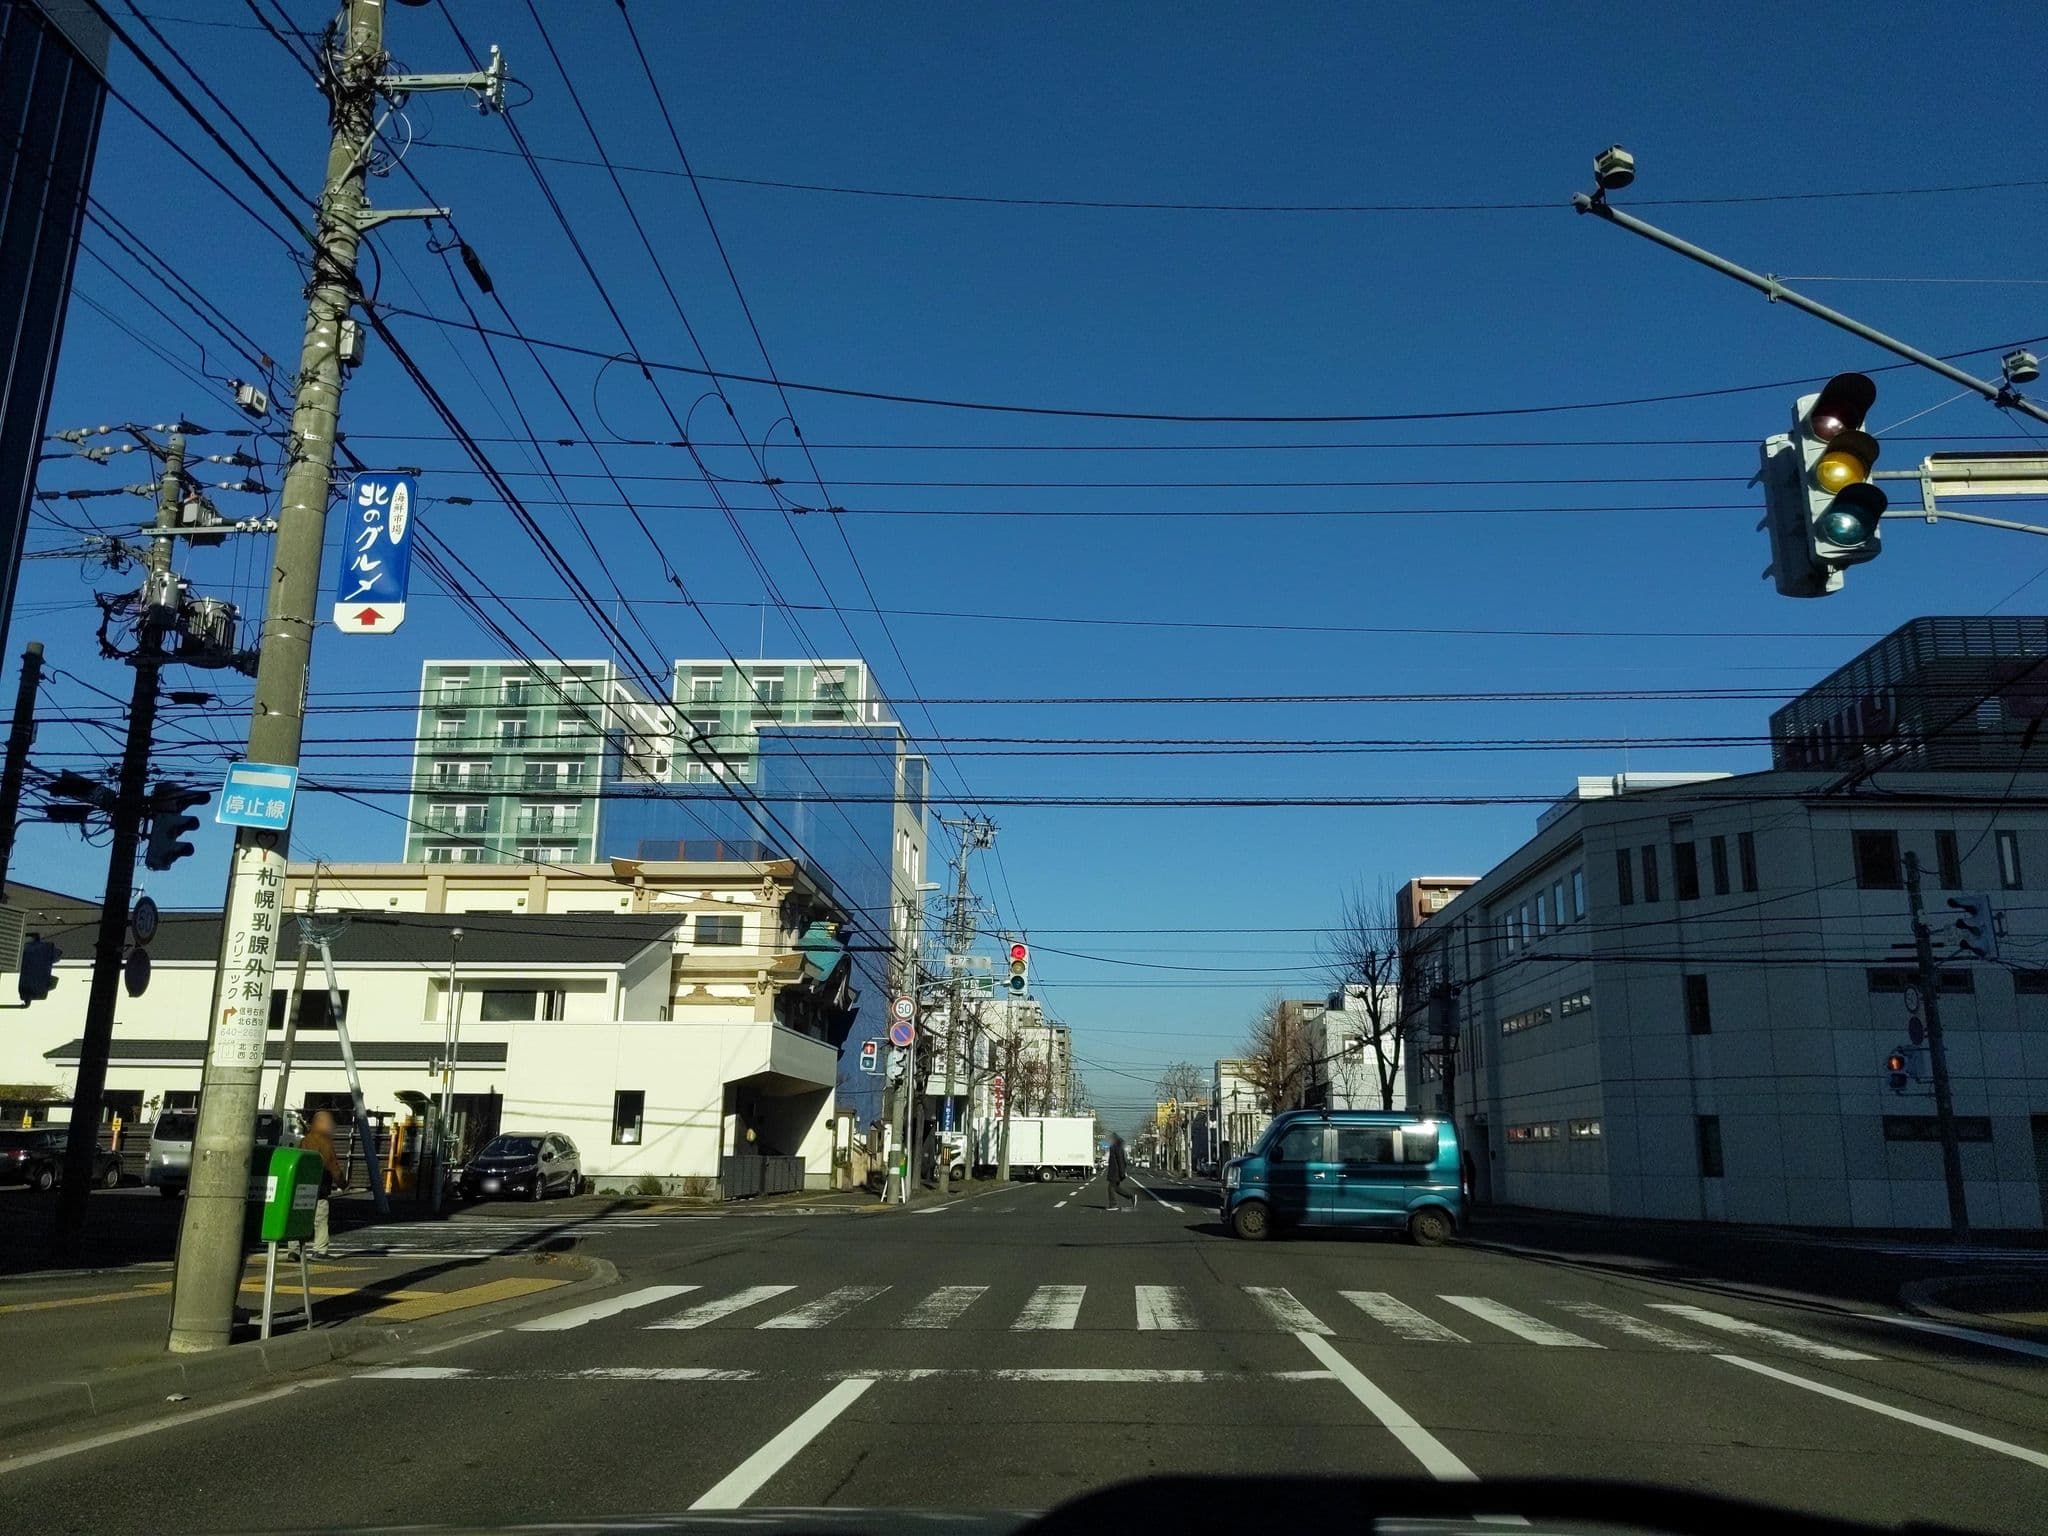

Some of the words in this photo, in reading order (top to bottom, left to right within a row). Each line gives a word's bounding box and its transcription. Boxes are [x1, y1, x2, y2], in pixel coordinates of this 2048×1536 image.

[344, 482, 389, 600] 北のグルメ
[225, 795, 286, 819] 停止線
[228, 931, 246, 1000] クリニック
[241, 866, 277, 1002] 札幌乳腺外科
[898, 1003, 911, 1014] 50
